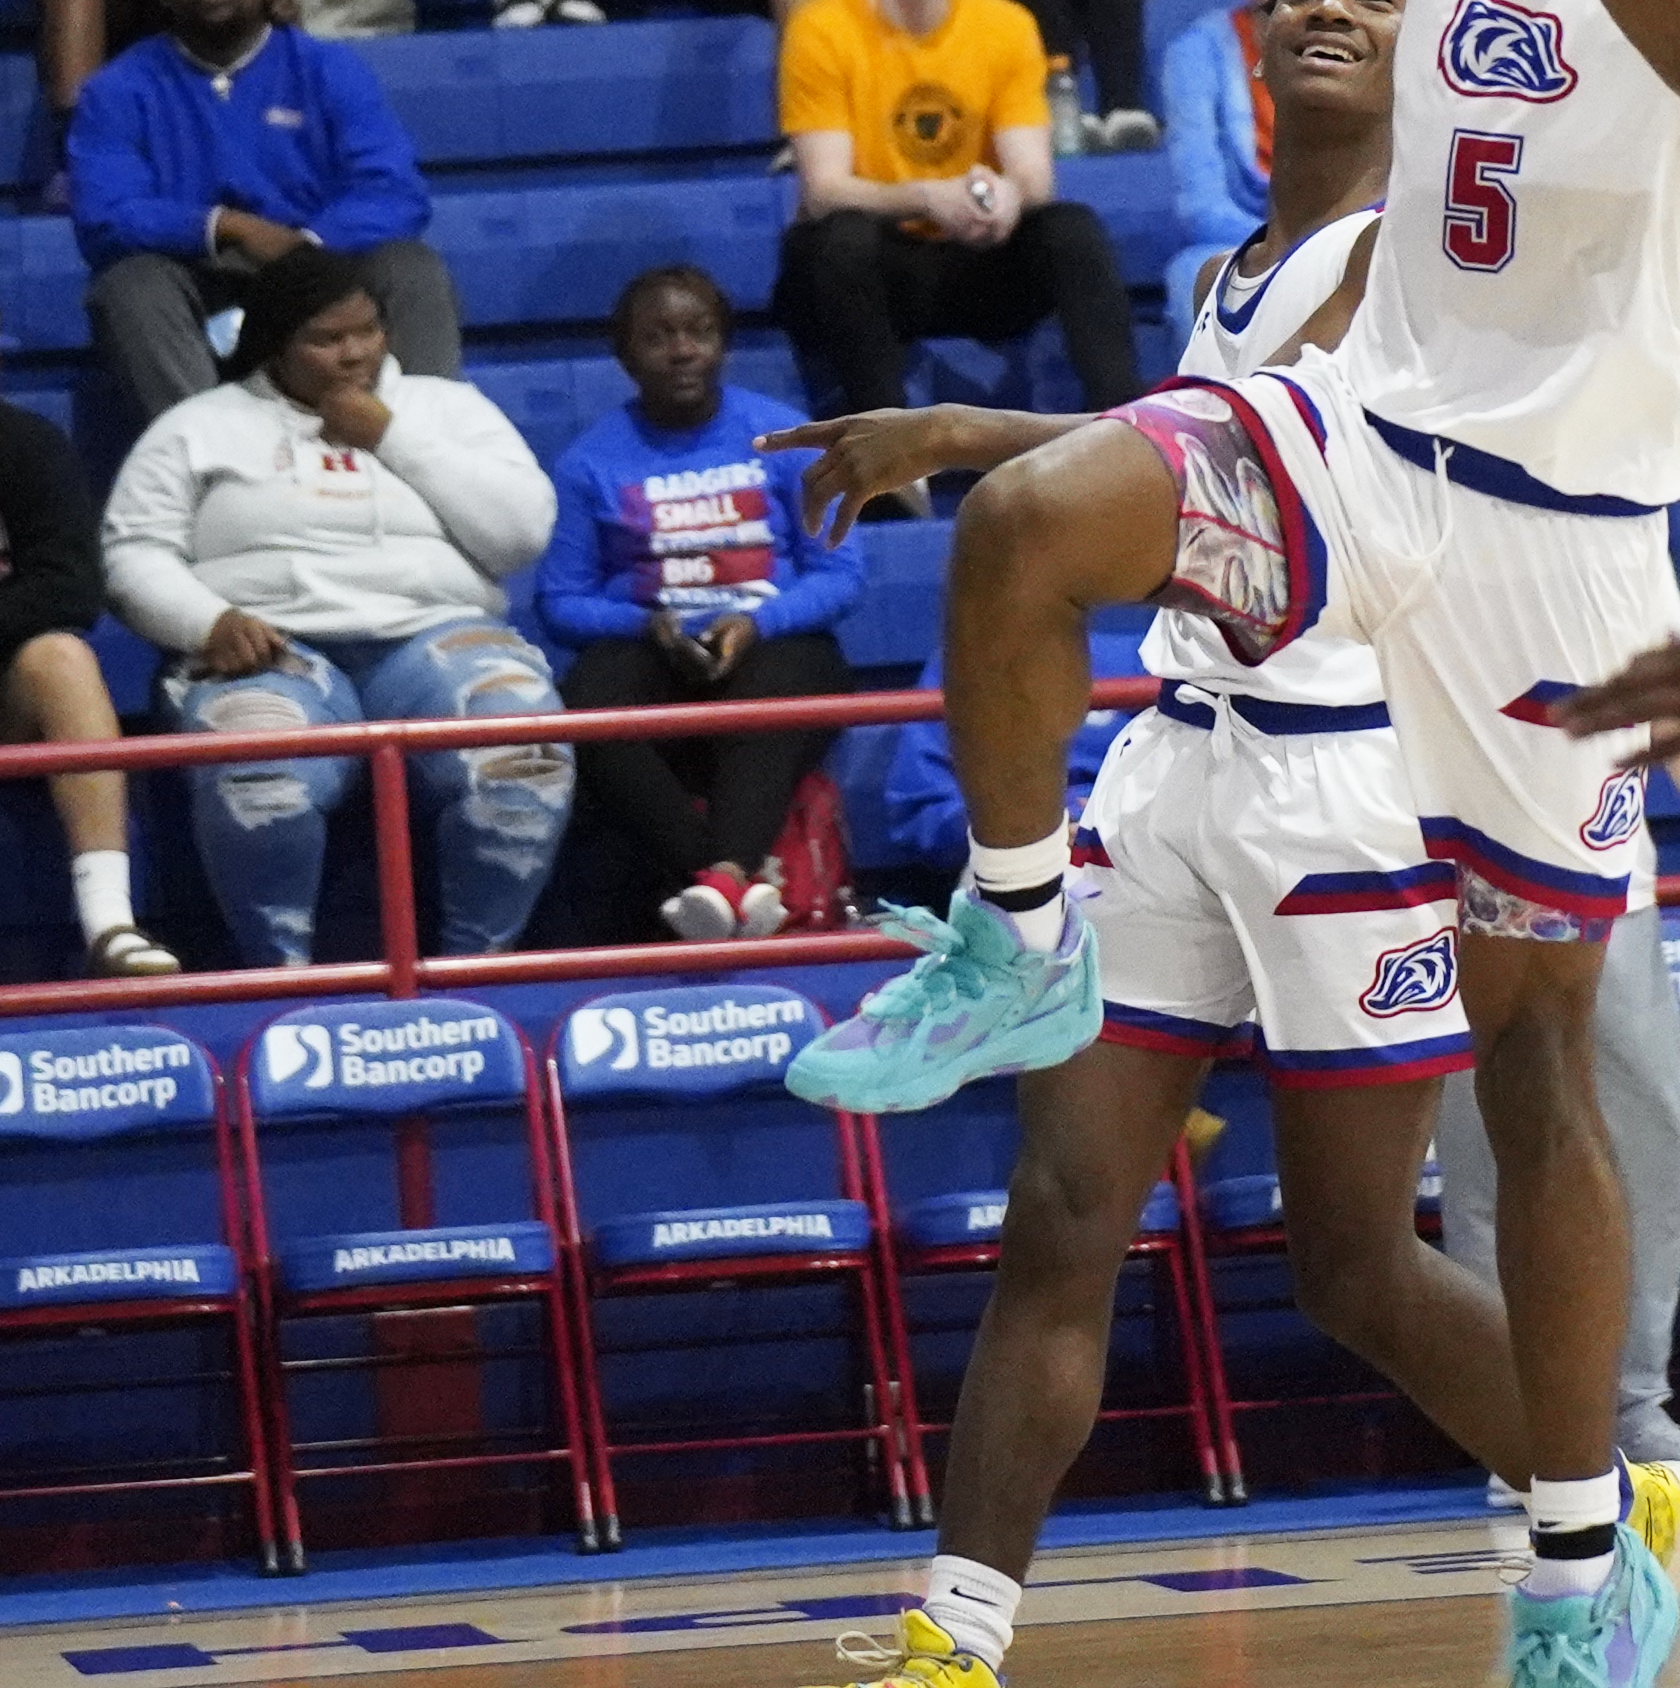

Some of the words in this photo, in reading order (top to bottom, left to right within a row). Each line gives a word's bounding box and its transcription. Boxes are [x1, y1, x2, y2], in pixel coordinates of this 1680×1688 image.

[1442, 128, 1525, 273] 5
[643, 458, 768, 503] BADGERS
[653, 494, 742, 531] SMALL
[661, 554, 715, 586] BIG
[338, 1016, 498, 1055] Southern
[643, 999, 805, 1037] Southern
[30, 1042, 191, 1081] Southern
[646, 1031, 792, 1068] Bancorp
[340, 1050, 485, 1087] Bancorp
[32, 1076, 177, 1112] Bancorp
[652, 1213, 835, 1248] ARKADELPHIA
[332, 1236, 516, 1274] ARKADELPHIA
[17, 1257, 202, 1293] ARKADELPHIA
